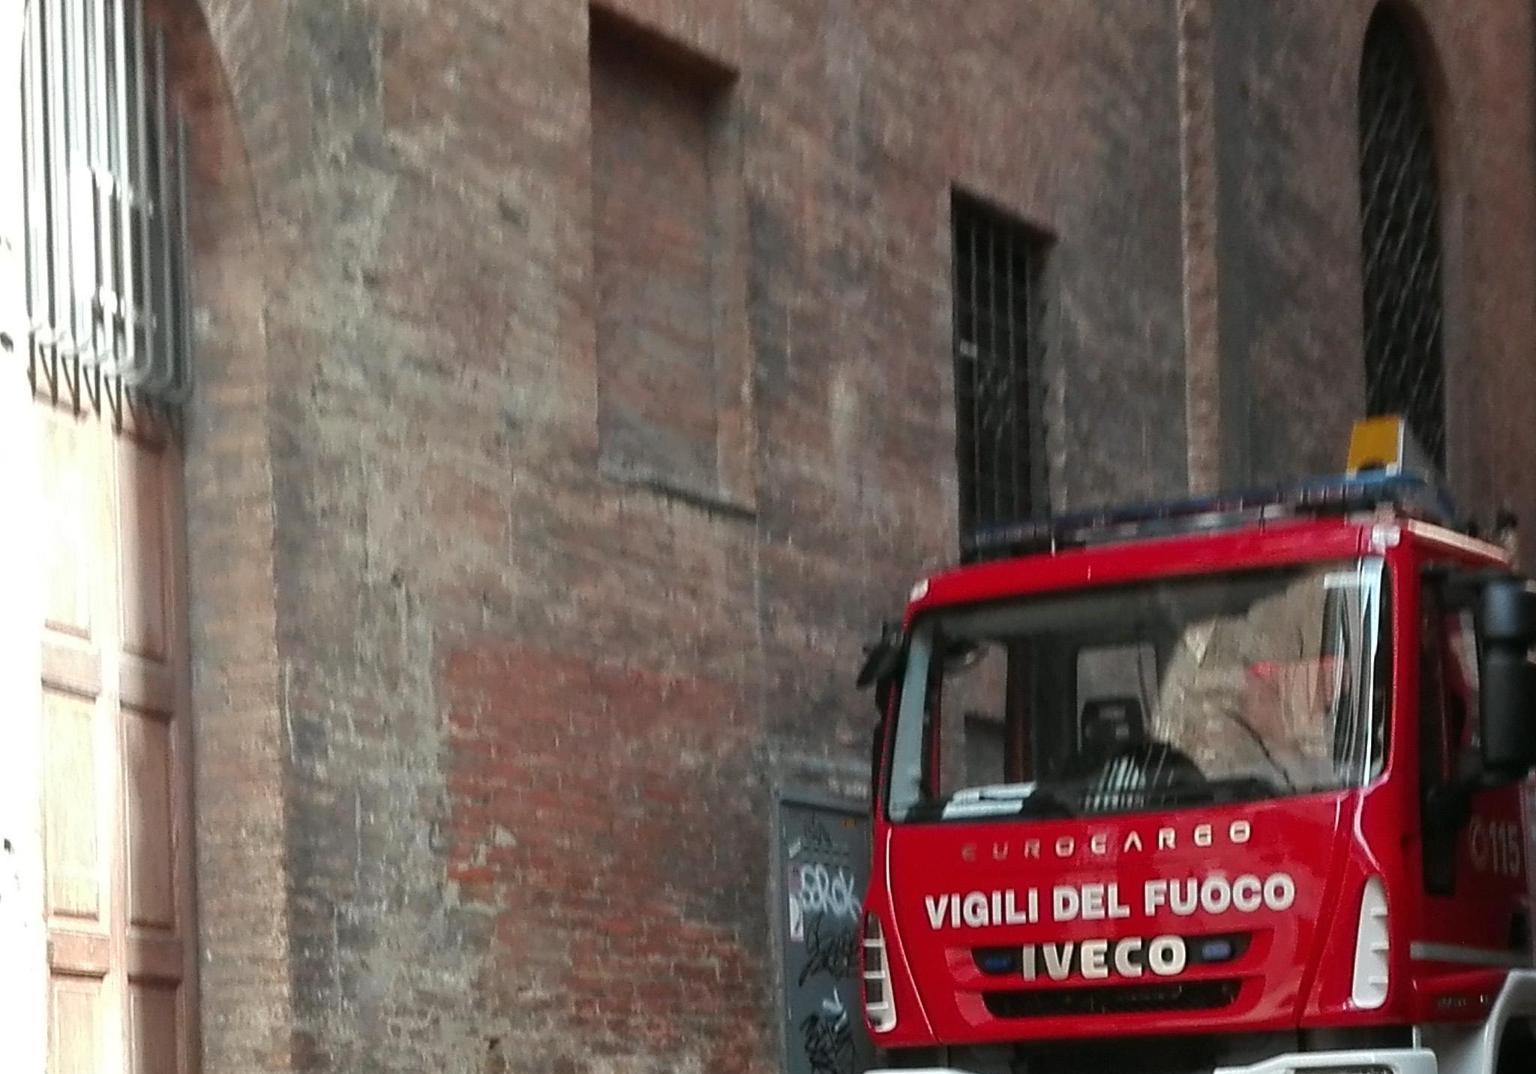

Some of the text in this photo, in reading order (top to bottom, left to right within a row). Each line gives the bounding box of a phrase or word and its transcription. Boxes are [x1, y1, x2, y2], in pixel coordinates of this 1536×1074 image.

[961, 819, 1252, 862] EUROCARGO
[1488, 819, 1520, 877] 115
[925, 872, 1296, 930] VIGILI DEL FUOCO
[1022, 934, 1187, 981] IVECO
